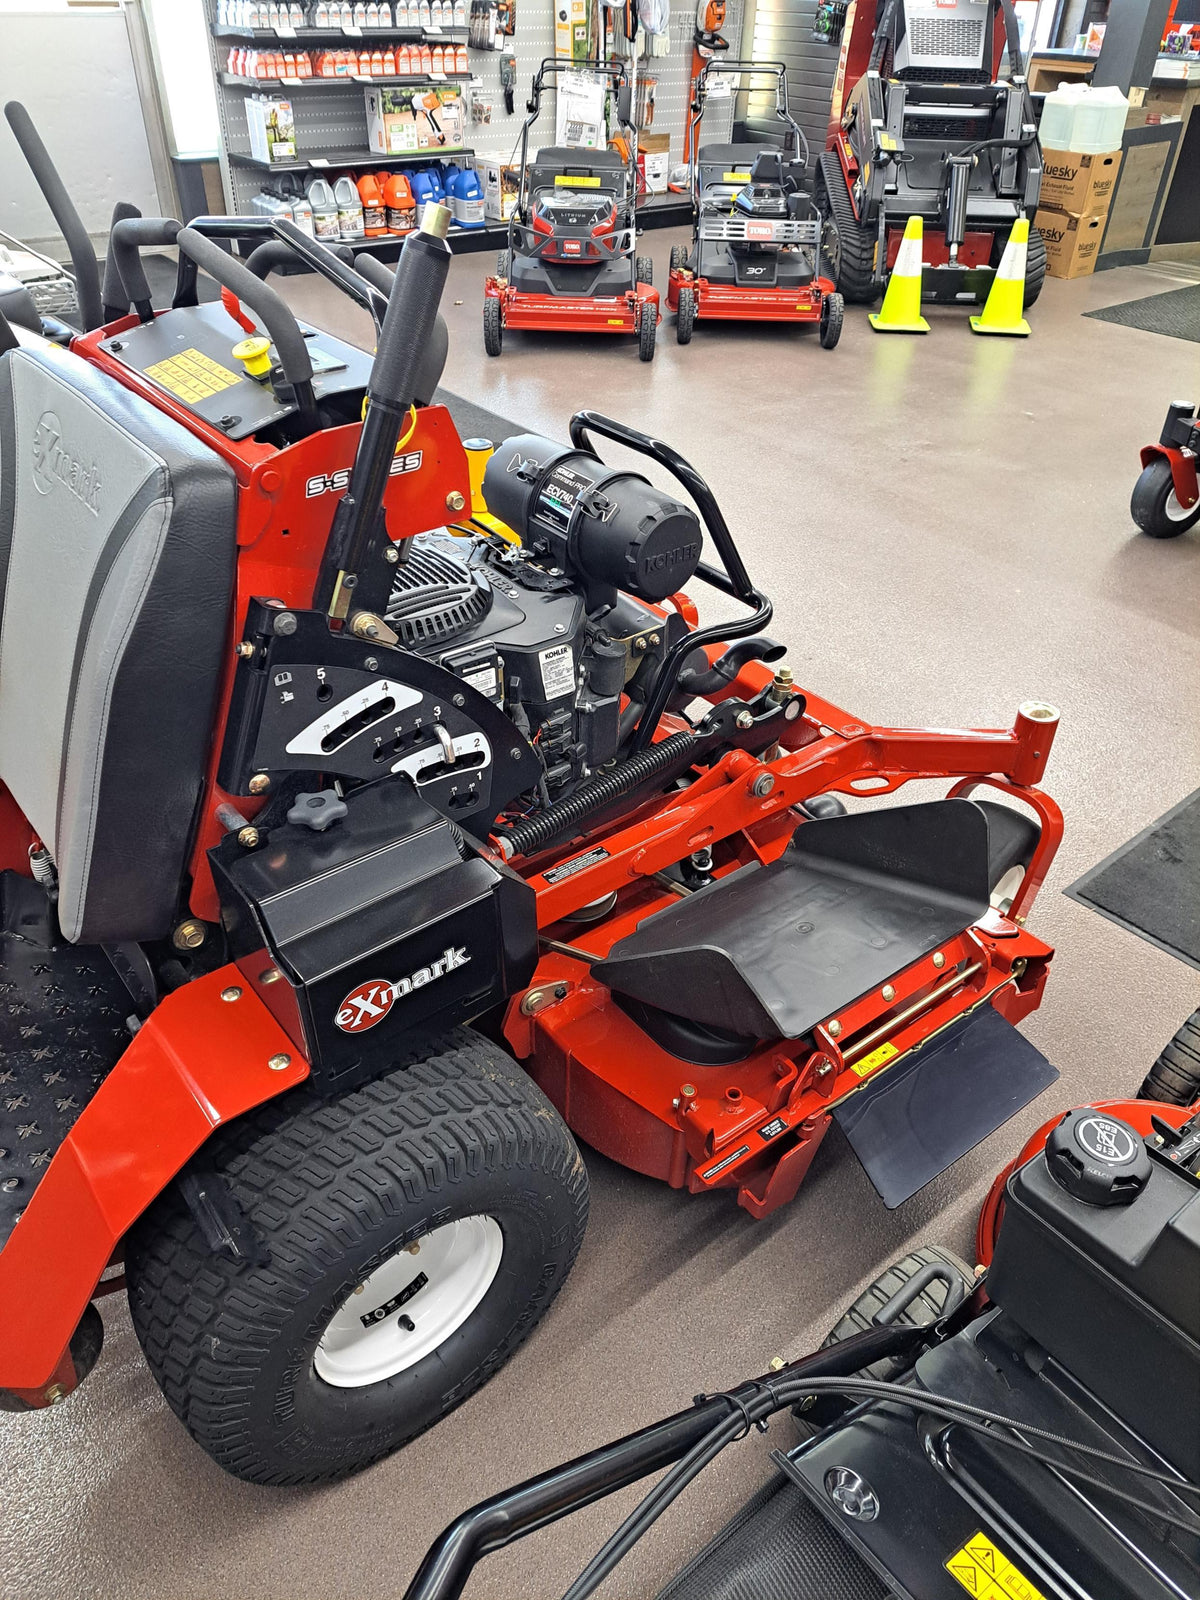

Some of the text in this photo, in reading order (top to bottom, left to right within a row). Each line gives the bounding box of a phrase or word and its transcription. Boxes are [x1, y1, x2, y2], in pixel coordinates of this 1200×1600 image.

[1043, 162, 1078, 180] luesky
[1093, 180, 1112, 190] bluesky
[749, 226, 771, 235] TORO
[306, 450, 422, 498] S-SES
[546, 483, 574, 504] ECV740
[643, 541, 698, 576] KOHLER
[544, 647, 568, 660] KOHLER
[316, 667, 326, 680] 5
[381, 681, 389, 691] 4
[433, 705, 442, 716] 3
[473, 738, 481, 748] 2
[476, 771, 482, 781] 1
[336, 946, 472, 1029] eXmark
[1095, 1143, 1115, 1157] E15
